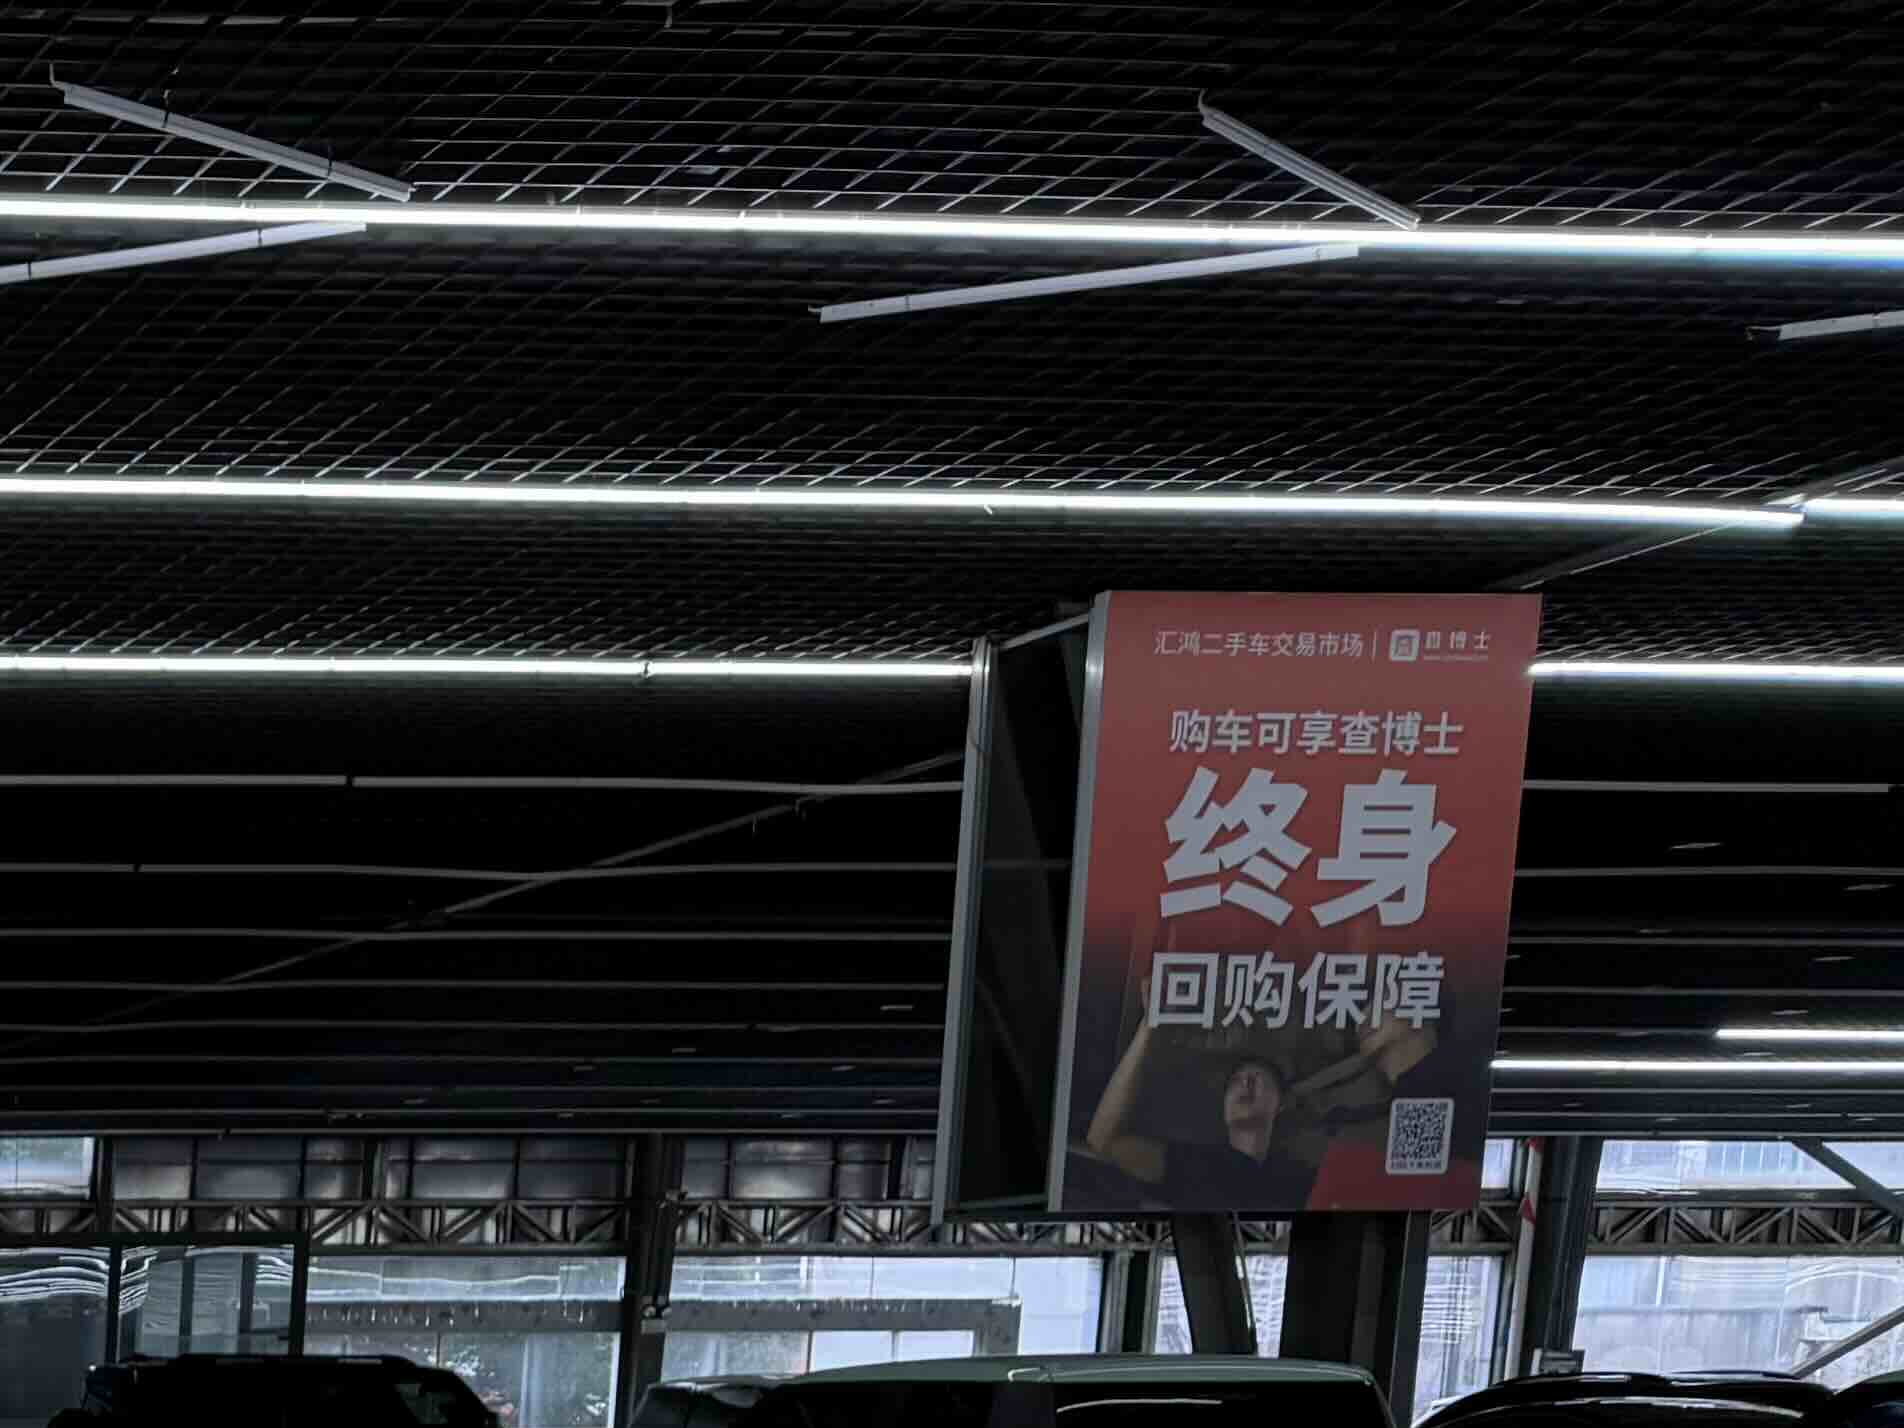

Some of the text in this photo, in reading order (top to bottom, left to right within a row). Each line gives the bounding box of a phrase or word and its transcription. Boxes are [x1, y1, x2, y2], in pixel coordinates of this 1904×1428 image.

[1169, 708, 1464, 756] 购车可享查博士
[1160, 765, 1457, 928] 终身
[1149, 950, 1444, 1030] 回购保障
